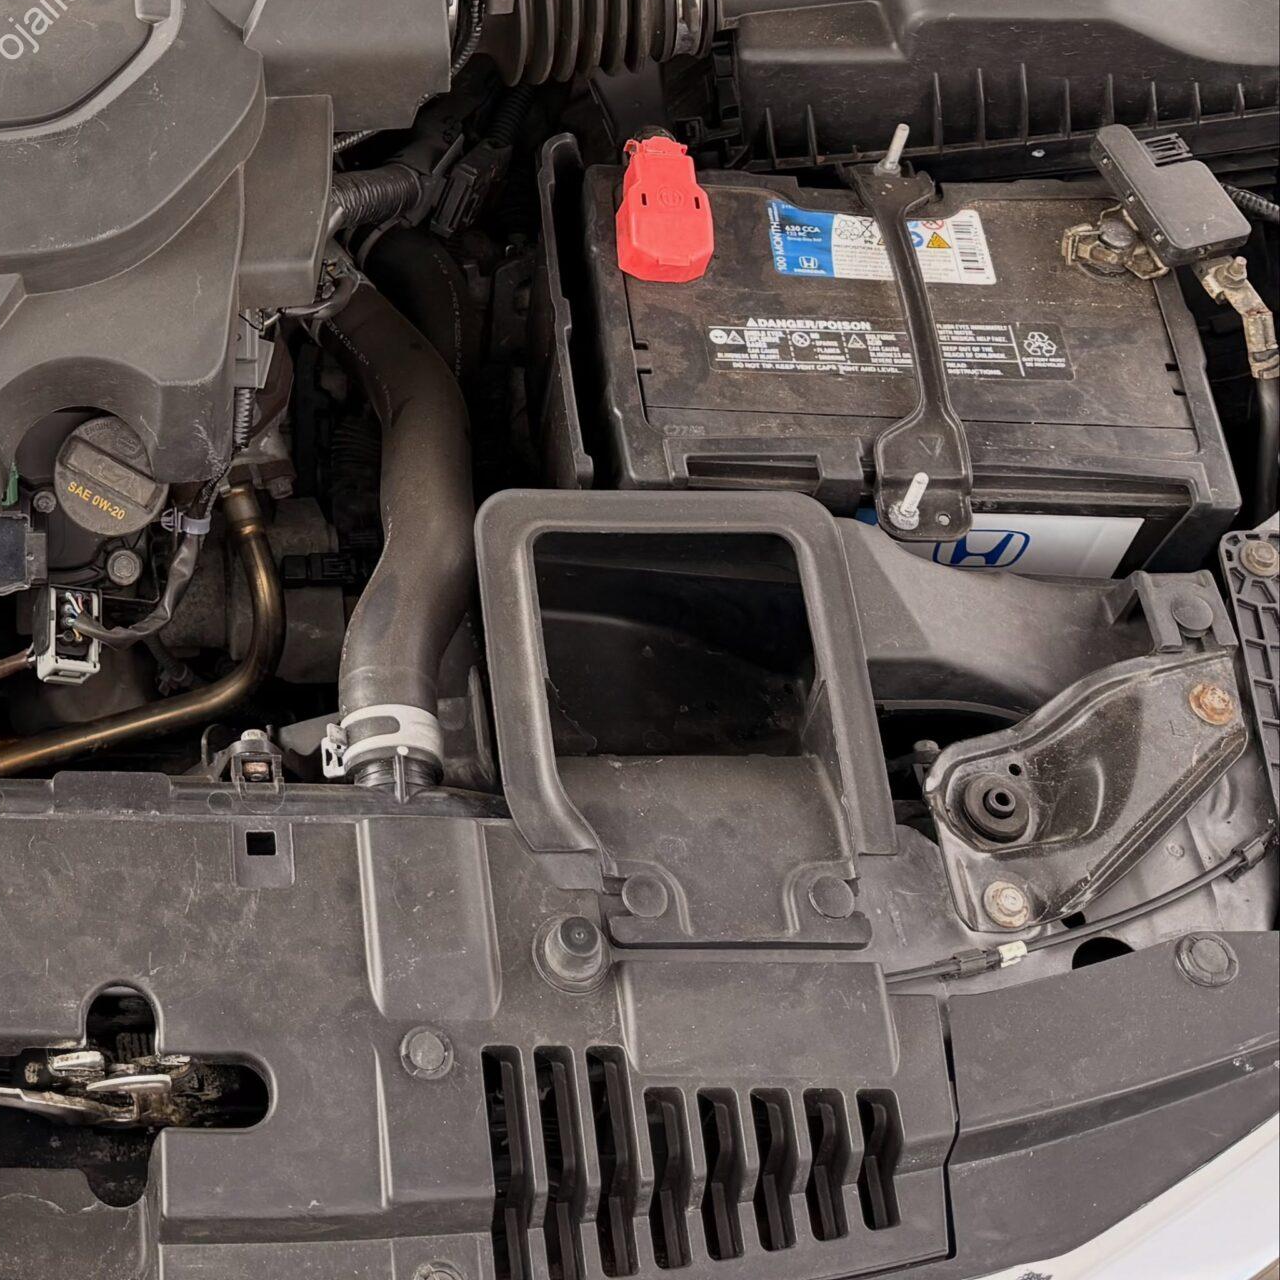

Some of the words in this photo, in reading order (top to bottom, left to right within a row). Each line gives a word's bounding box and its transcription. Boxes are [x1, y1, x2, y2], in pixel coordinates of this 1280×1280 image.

[771, 221, 784, 255] MONTH
[68, 481, 93, 501] SAE
[91, 495, 126, 520] 0W-20
